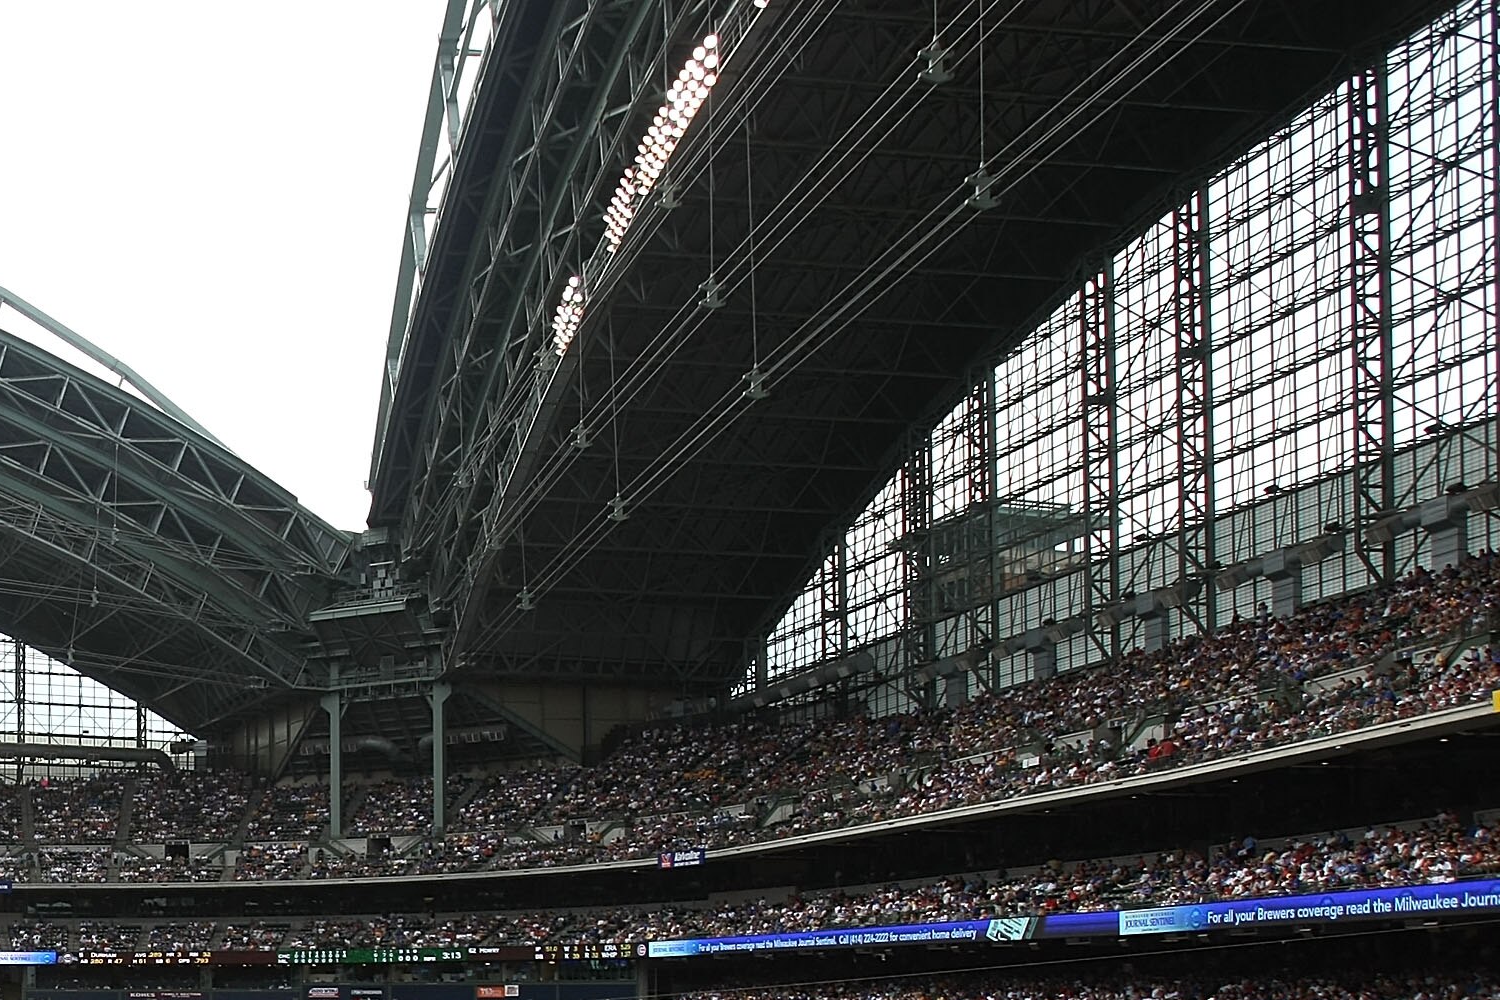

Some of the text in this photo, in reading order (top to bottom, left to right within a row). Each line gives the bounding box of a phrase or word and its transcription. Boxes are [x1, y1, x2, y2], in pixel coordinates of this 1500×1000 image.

[1207, 911, 1221, 924] For
[1223, 909, 1233, 922] all
[1235, 911, 1255, 925] your
[1257, 907, 1295, 921] Brewers
[1297, 904, 1343, 920] coverage
[1346, 899, 1371, 915] read
[1373, 897, 1392, 913] the
[1394, 893, 1458, 912] Milwaukee
[1125, 919, 1148, 930] JOURNAL
[711, 945, 719, 953] your
[720, 942, 736, 951] Brewers
[736, 943, 755, 952] coverage
[756, 940, 765, 948] read
[774, 939, 797, 947] Milwaukee
[798, 937, 815, 946] Journal
[839, 935, 849, 945] Call
[850, 934, 863, 945] (414)
[864, 932, 889, 944] 224-2222
[890, 932, 898, 942] for
[899, 931, 930, 942] convenient
[932, 930, 950, 940] home
[950, 928, 977, 940] delivery
